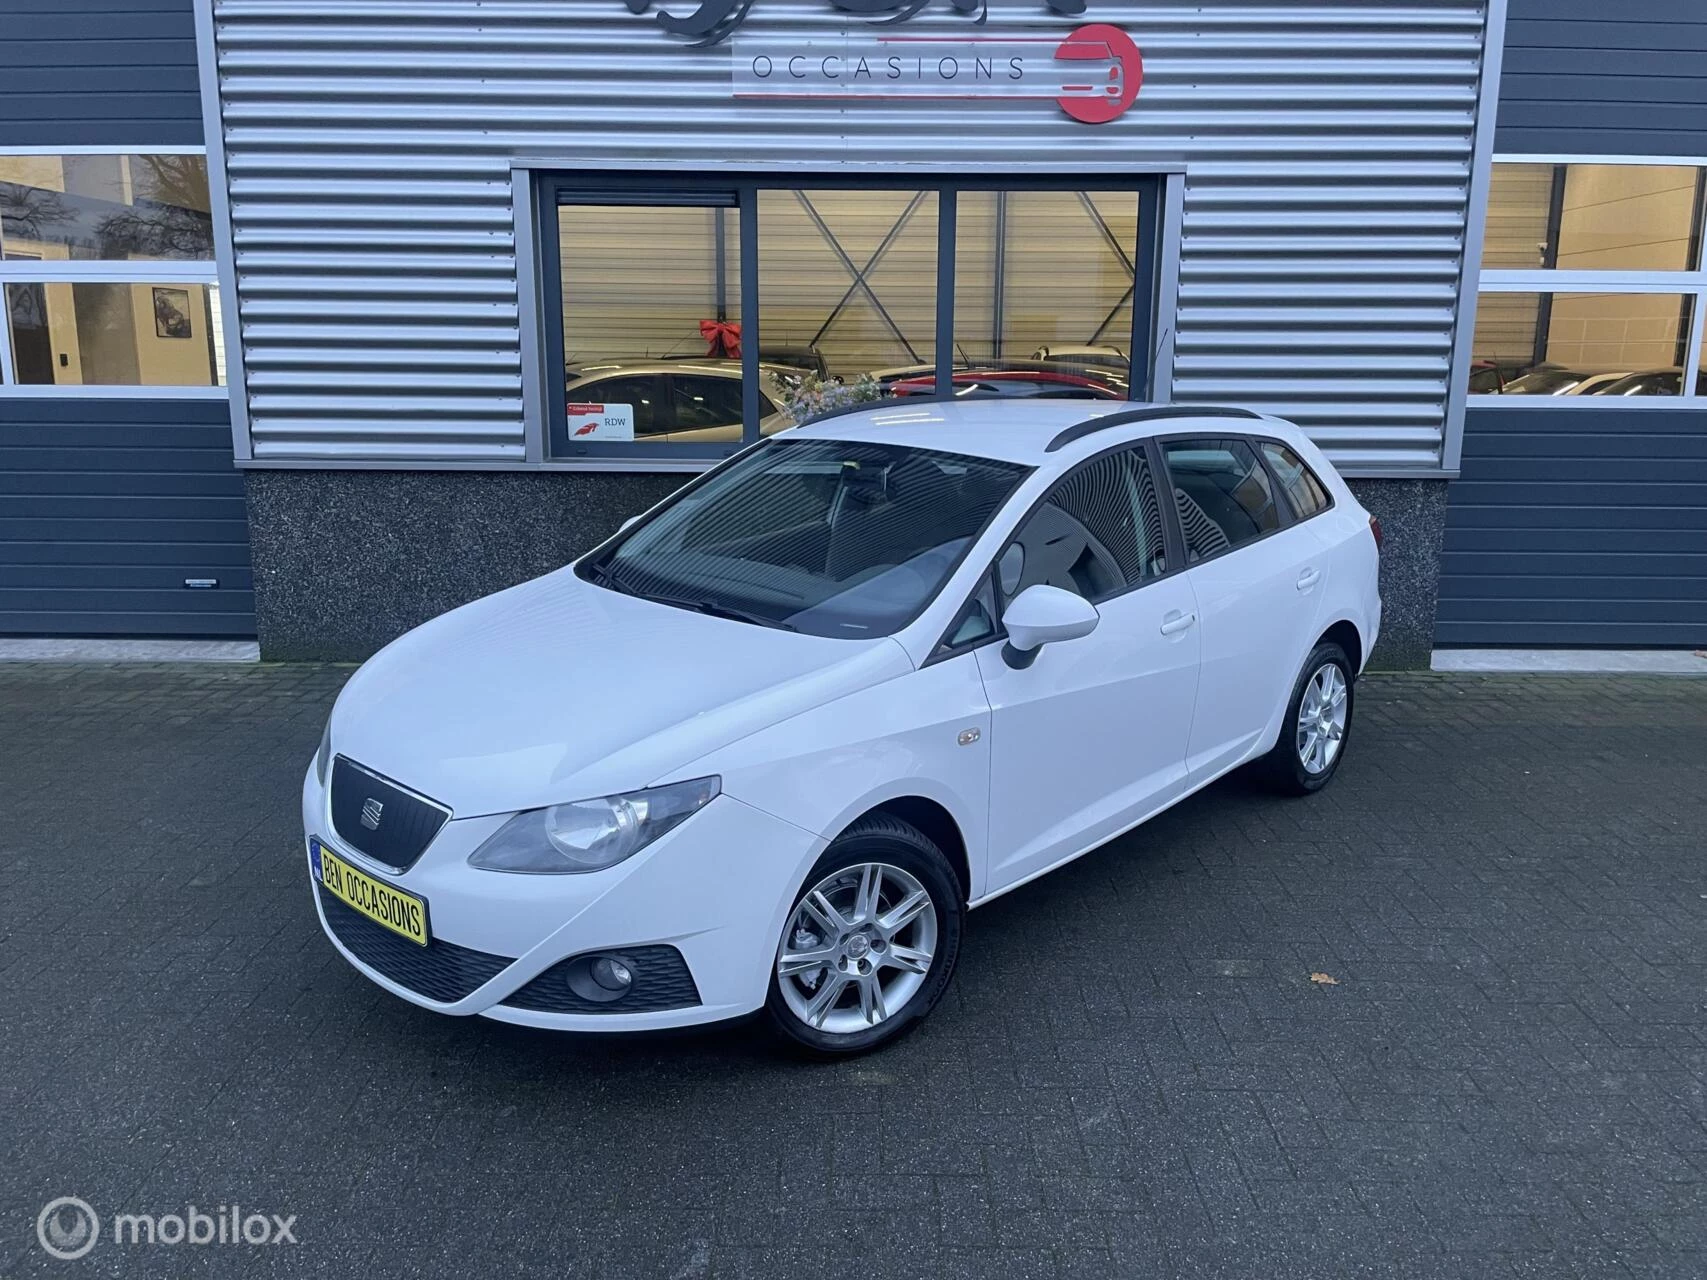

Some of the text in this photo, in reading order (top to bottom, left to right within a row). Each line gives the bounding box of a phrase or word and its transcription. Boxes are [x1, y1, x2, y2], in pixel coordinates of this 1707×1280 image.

[752, 55, 1024, 80] OCCASIONS
[604, 418, 625, 426] RDW
[323, 854, 421, 937] BEN OCCASIONS
